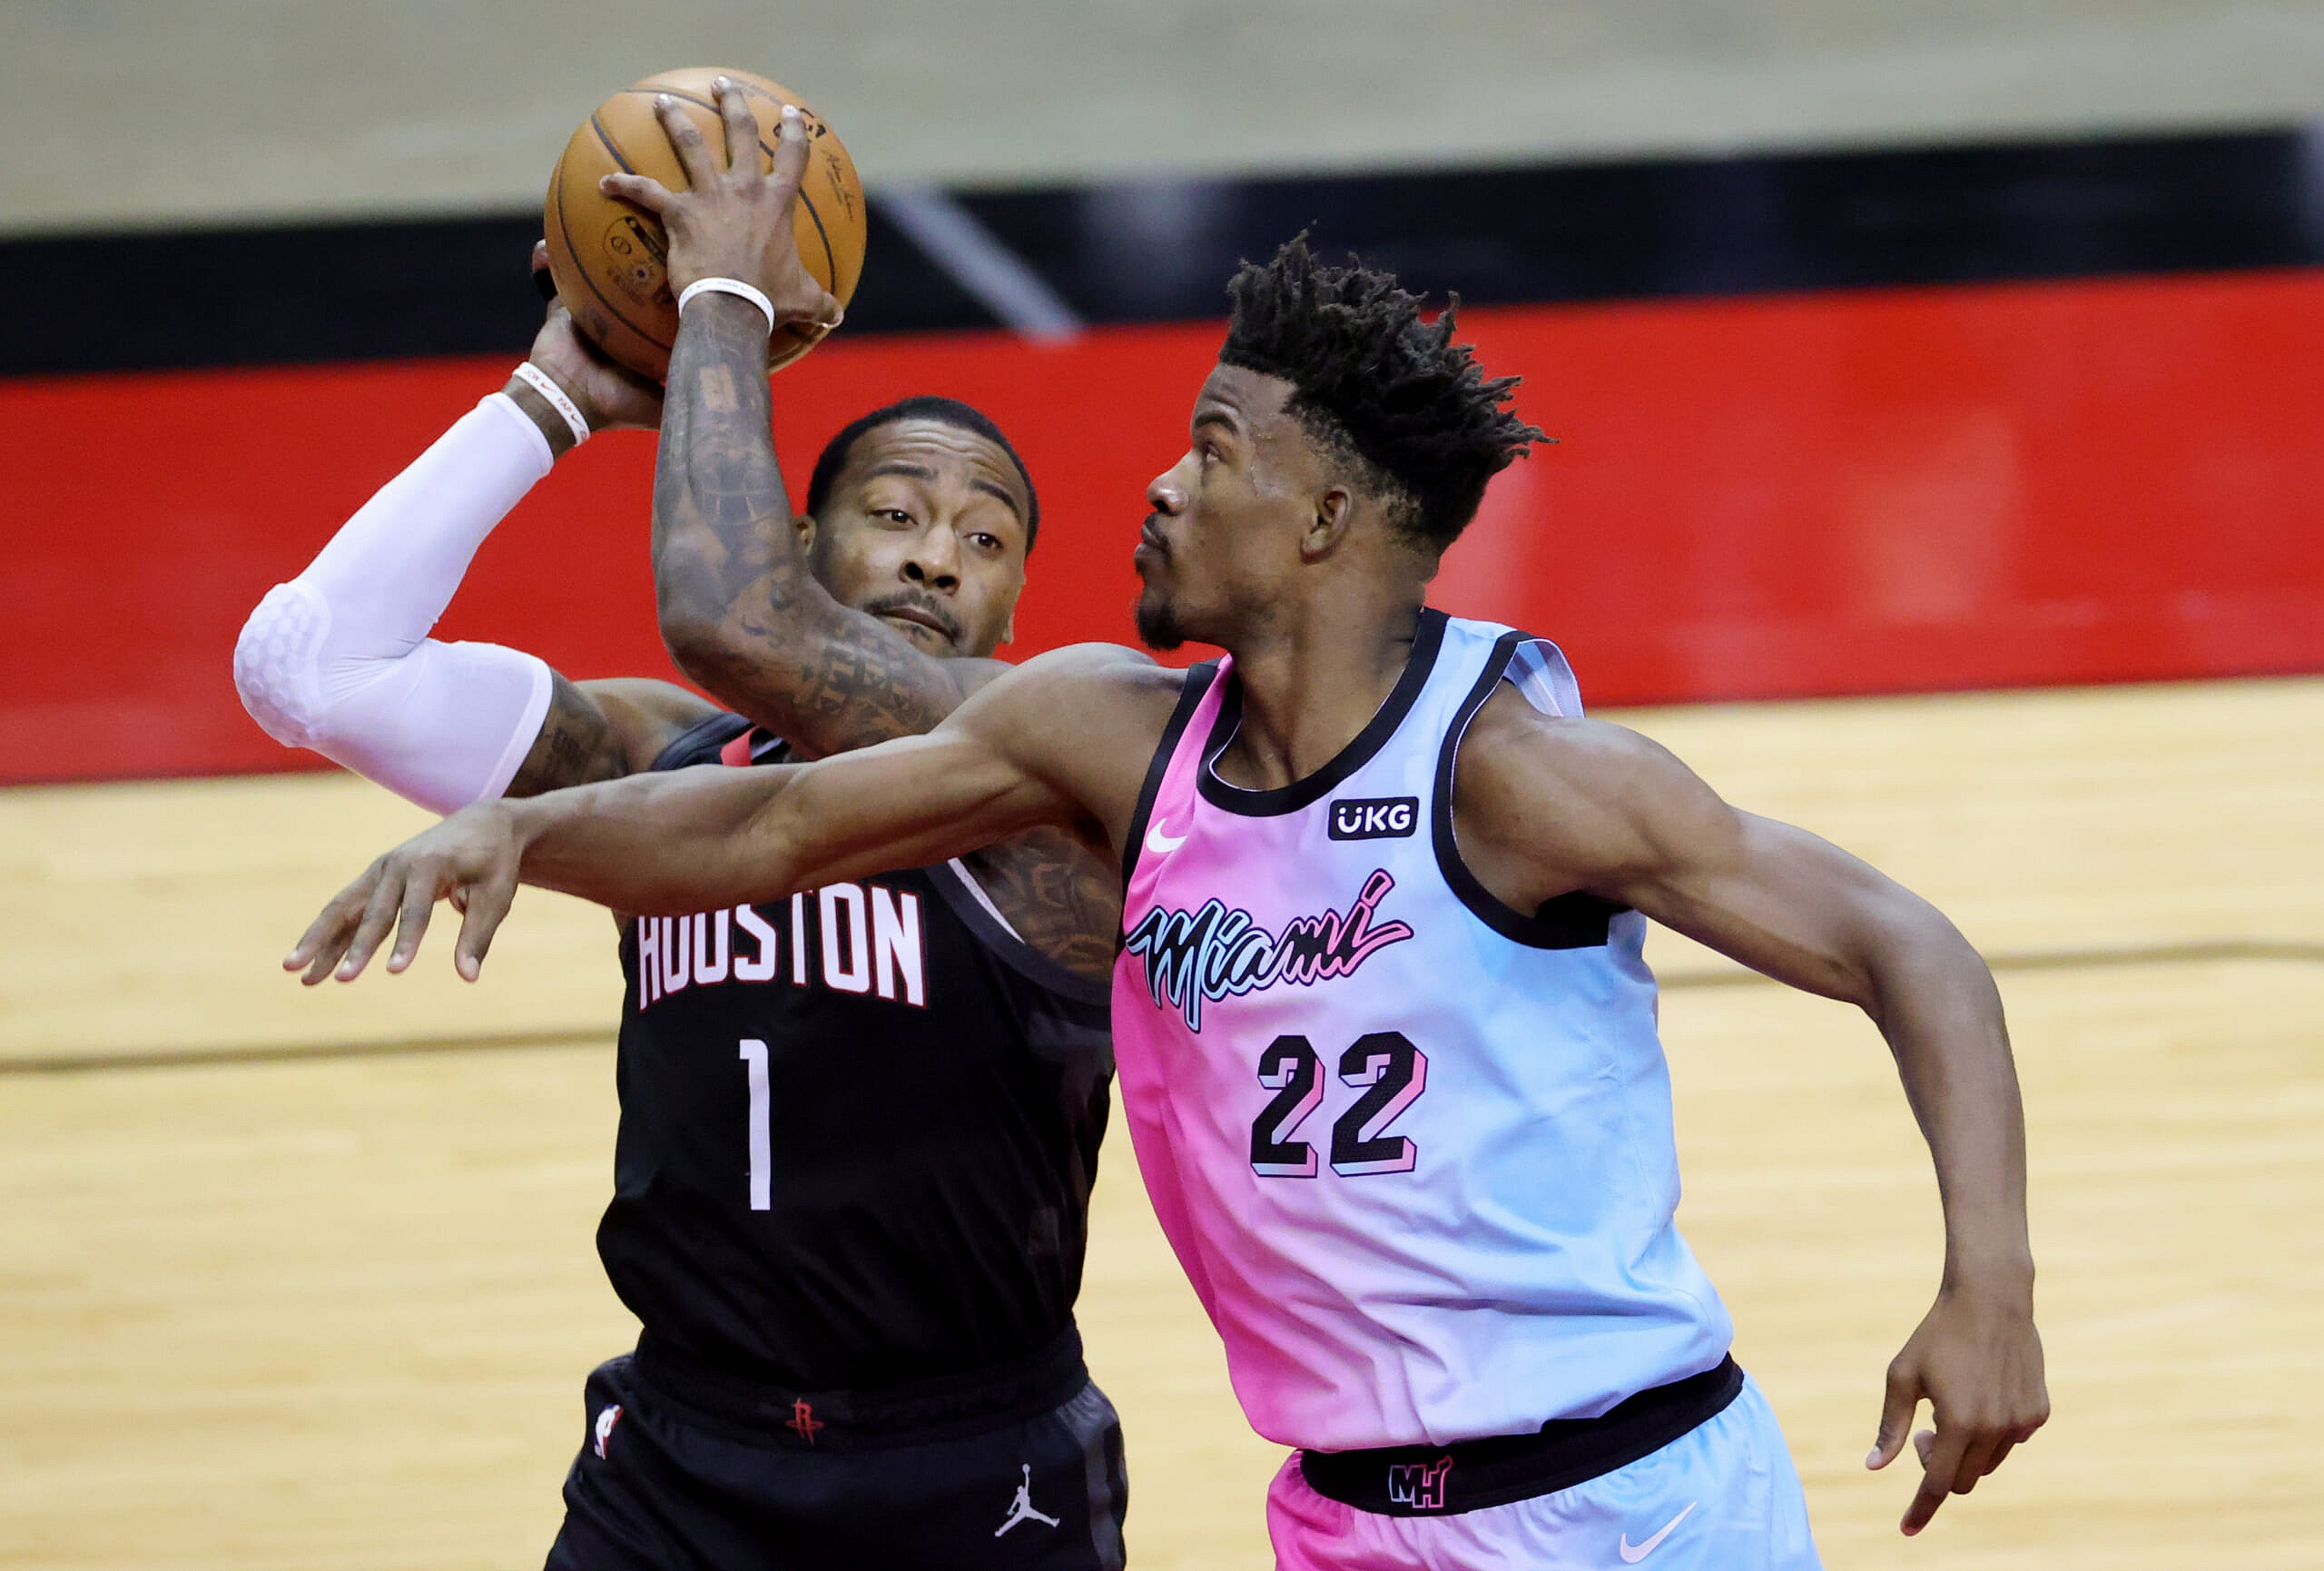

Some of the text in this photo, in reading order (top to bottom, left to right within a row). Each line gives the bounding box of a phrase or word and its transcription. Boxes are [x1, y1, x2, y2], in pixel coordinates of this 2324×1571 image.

[638, 882, 927, 1011] HOUSTON
[1124, 868, 1414, 1033] Miami
[739, 1039, 771, 1210] 1
[1250, 1032, 1428, 1180] 22
